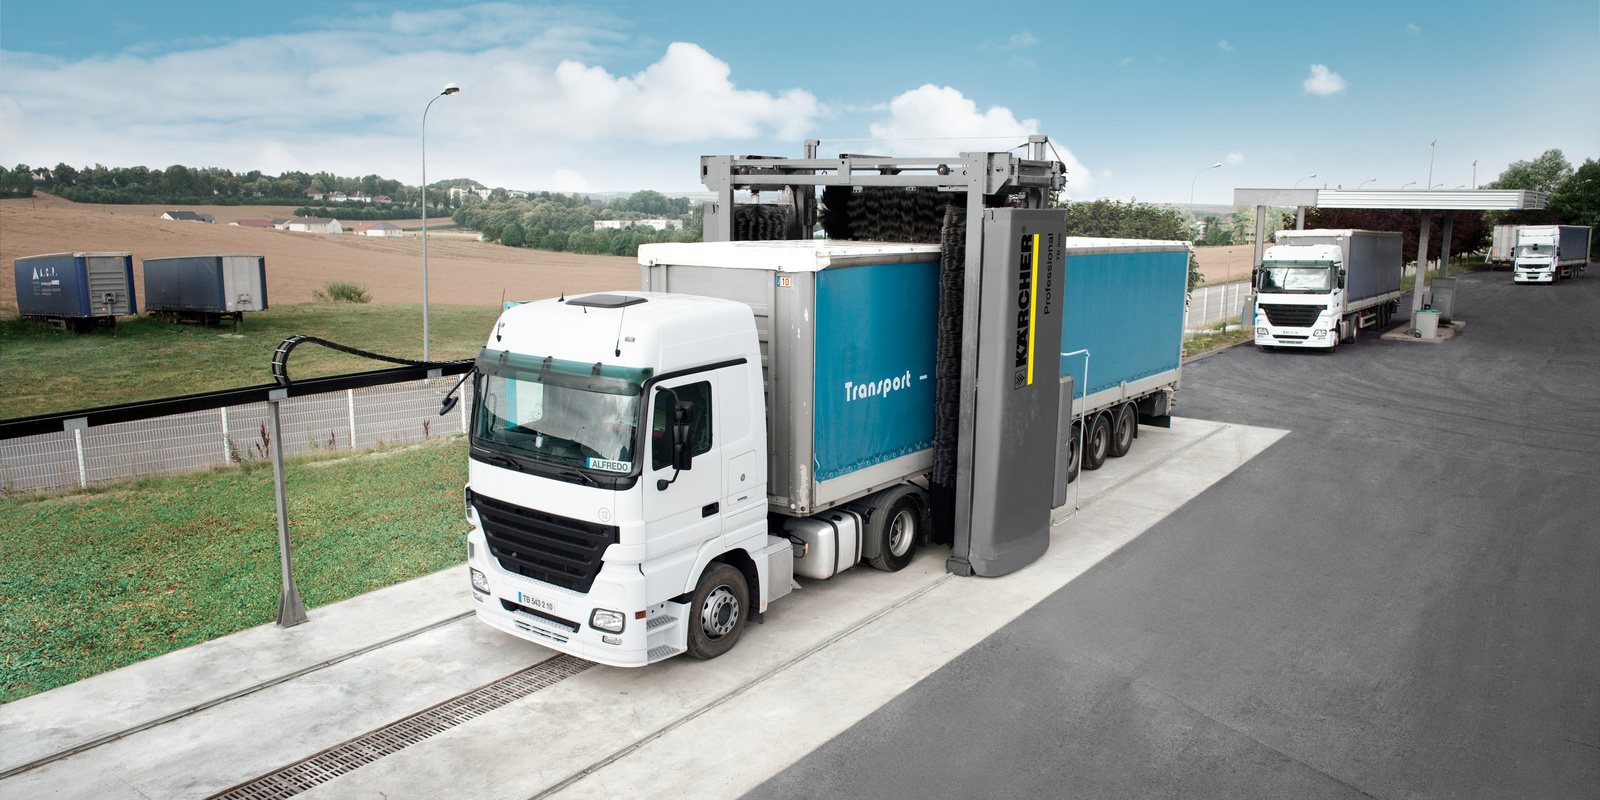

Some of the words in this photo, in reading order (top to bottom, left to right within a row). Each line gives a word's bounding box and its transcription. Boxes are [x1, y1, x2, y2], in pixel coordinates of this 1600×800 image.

[1055, 250, 1062, 261] TB
[1043, 232, 1054, 315] Professional
[781, 277, 790, 286] 10
[844, 370, 911, 402] Transport
[592, 460, 628, 471] ALFREDO
[522, 594, 531, 604] TB
[531, 597, 541, 607] 543
[546, 603, 553, 611] 10
